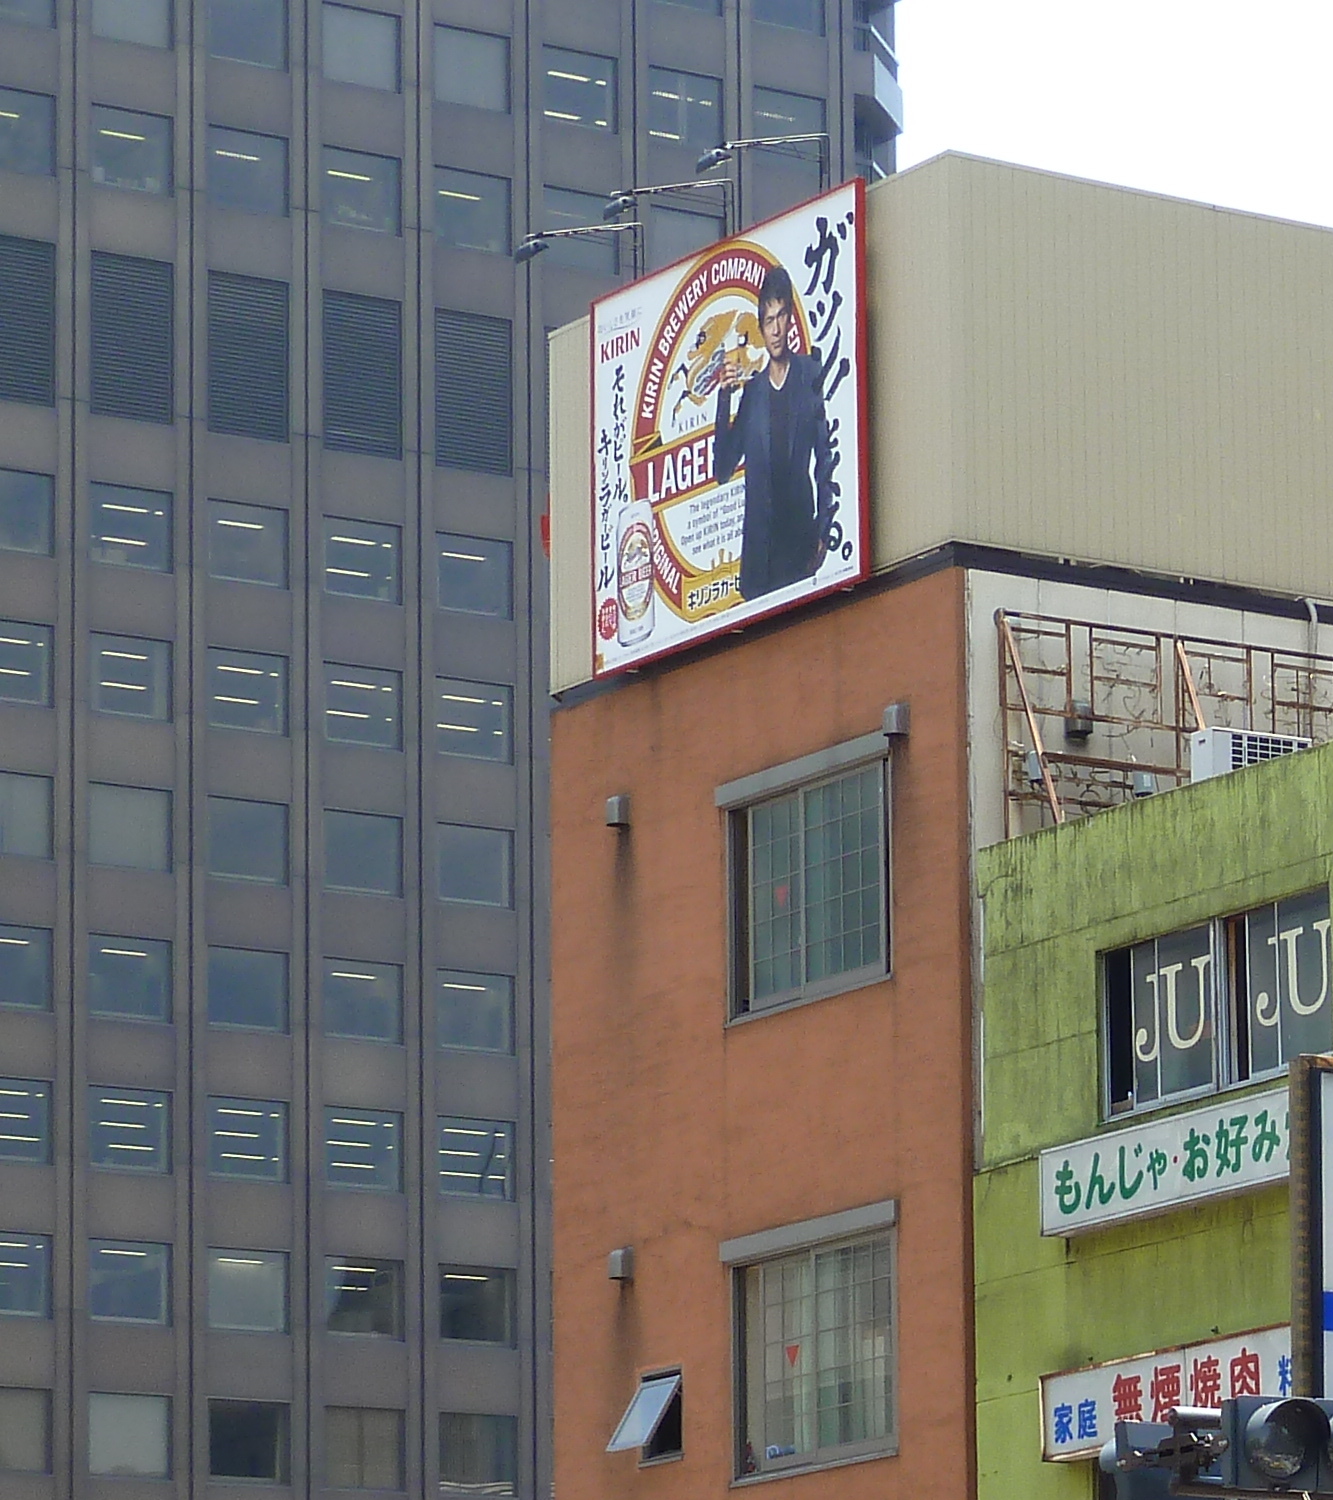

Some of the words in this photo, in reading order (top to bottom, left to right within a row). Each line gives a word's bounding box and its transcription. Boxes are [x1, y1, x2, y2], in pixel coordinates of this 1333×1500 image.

[600, 327, 641, 364] KIRIN
[641, 357, 665, 419] KIRIN
[657, 270, 708, 357] BREWERY
[711, 257, 766, 290] COMPAN
[678, 412, 708, 434] KIRIN
[652, 520, 682, 594] IGINAL
[1135, 953, 1212, 1064] JU
[1054, 1108, 1290, 1215] もんじゃ・お好み
[1053, 1398, 1098, 1445] 家庭
[1112, 1347, 1261, 1424] 無煙焼肉
